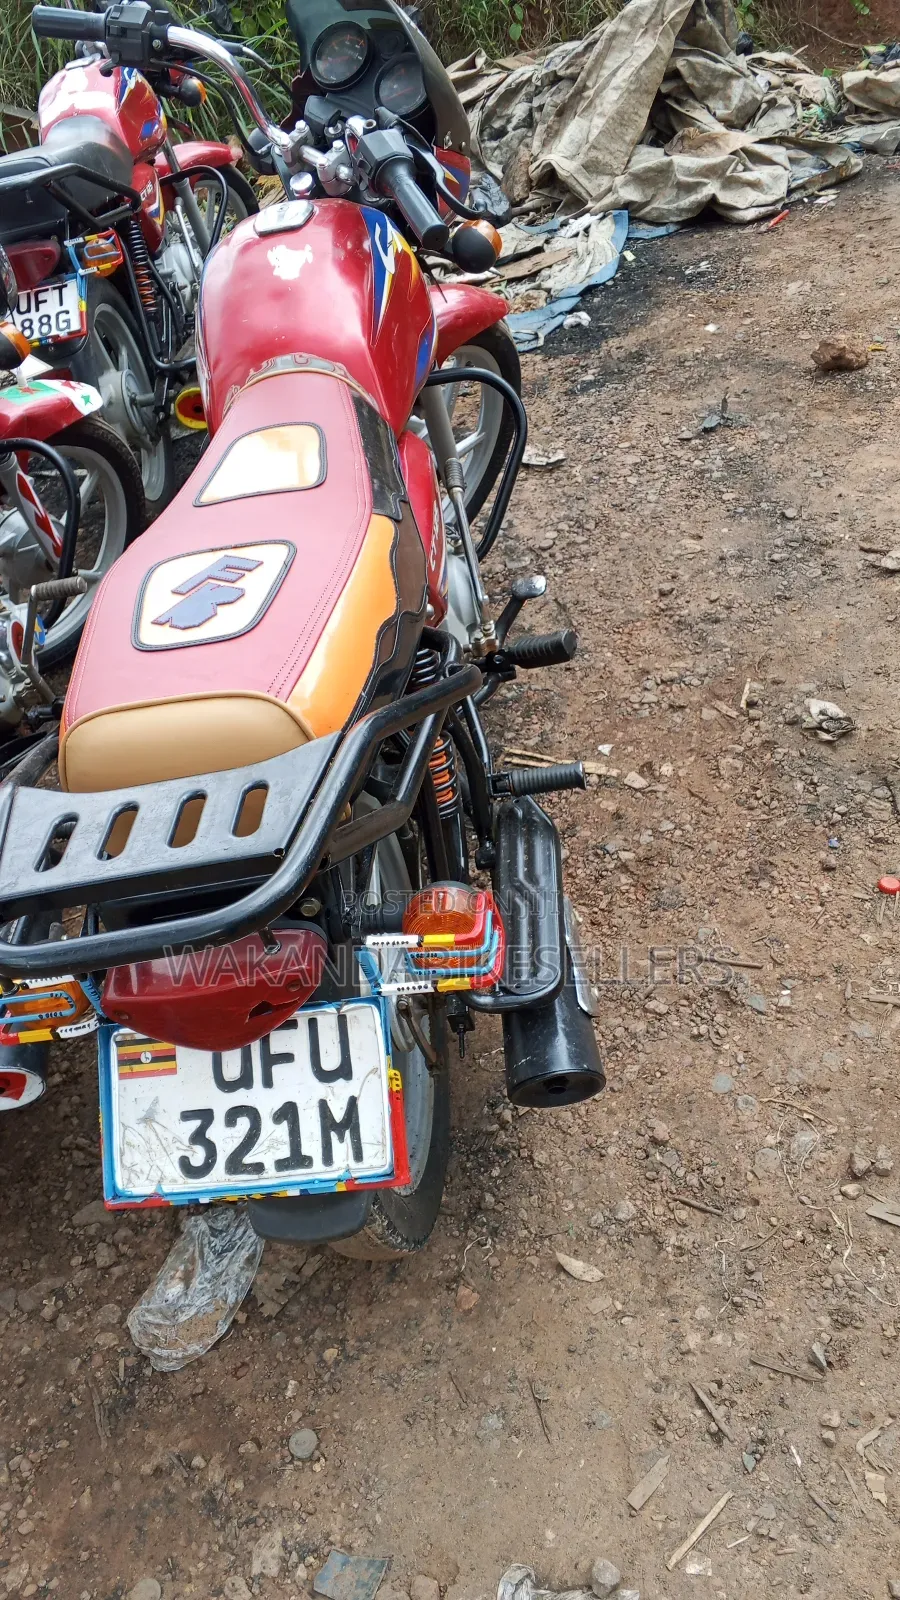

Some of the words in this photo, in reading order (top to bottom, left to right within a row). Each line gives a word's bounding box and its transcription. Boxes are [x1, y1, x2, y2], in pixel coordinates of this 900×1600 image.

[16, 284, 68, 315] UFT
[212, 1014, 353, 1093] UFU
[179, 1095, 364, 1180] 321M
